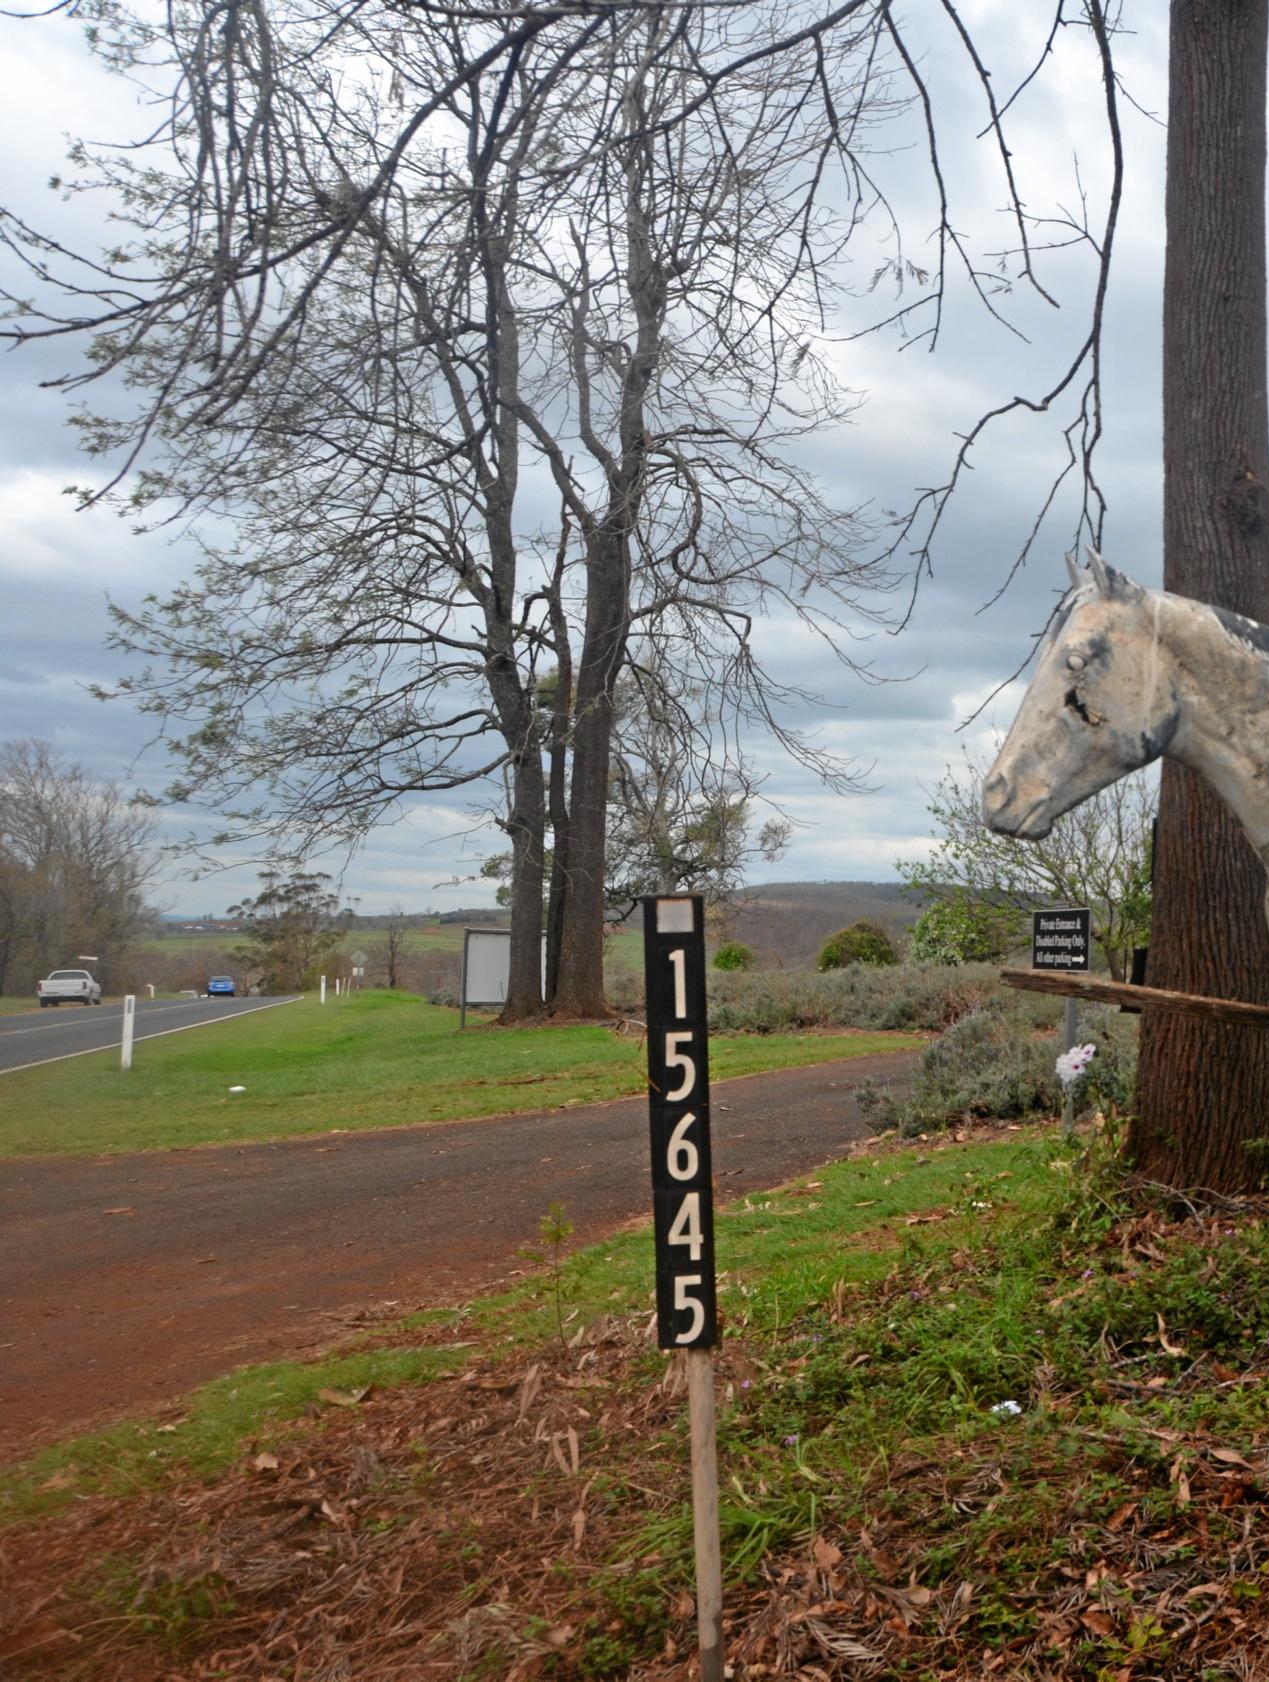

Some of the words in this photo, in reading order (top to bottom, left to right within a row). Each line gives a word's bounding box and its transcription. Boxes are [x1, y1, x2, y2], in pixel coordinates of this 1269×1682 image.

[1040, 918, 1056, 930] Private
[1055, 918, 1075, 930] Entrance
[1076, 917, 1082, 930] &
[1036, 935, 1054, 947] Disabled
[1054, 935, 1072, 950] Parking
[1043, 951, 1054, 963] other
[1054, 951, 1072, 966] parking
[665, 948, 704, 1344] 15645
